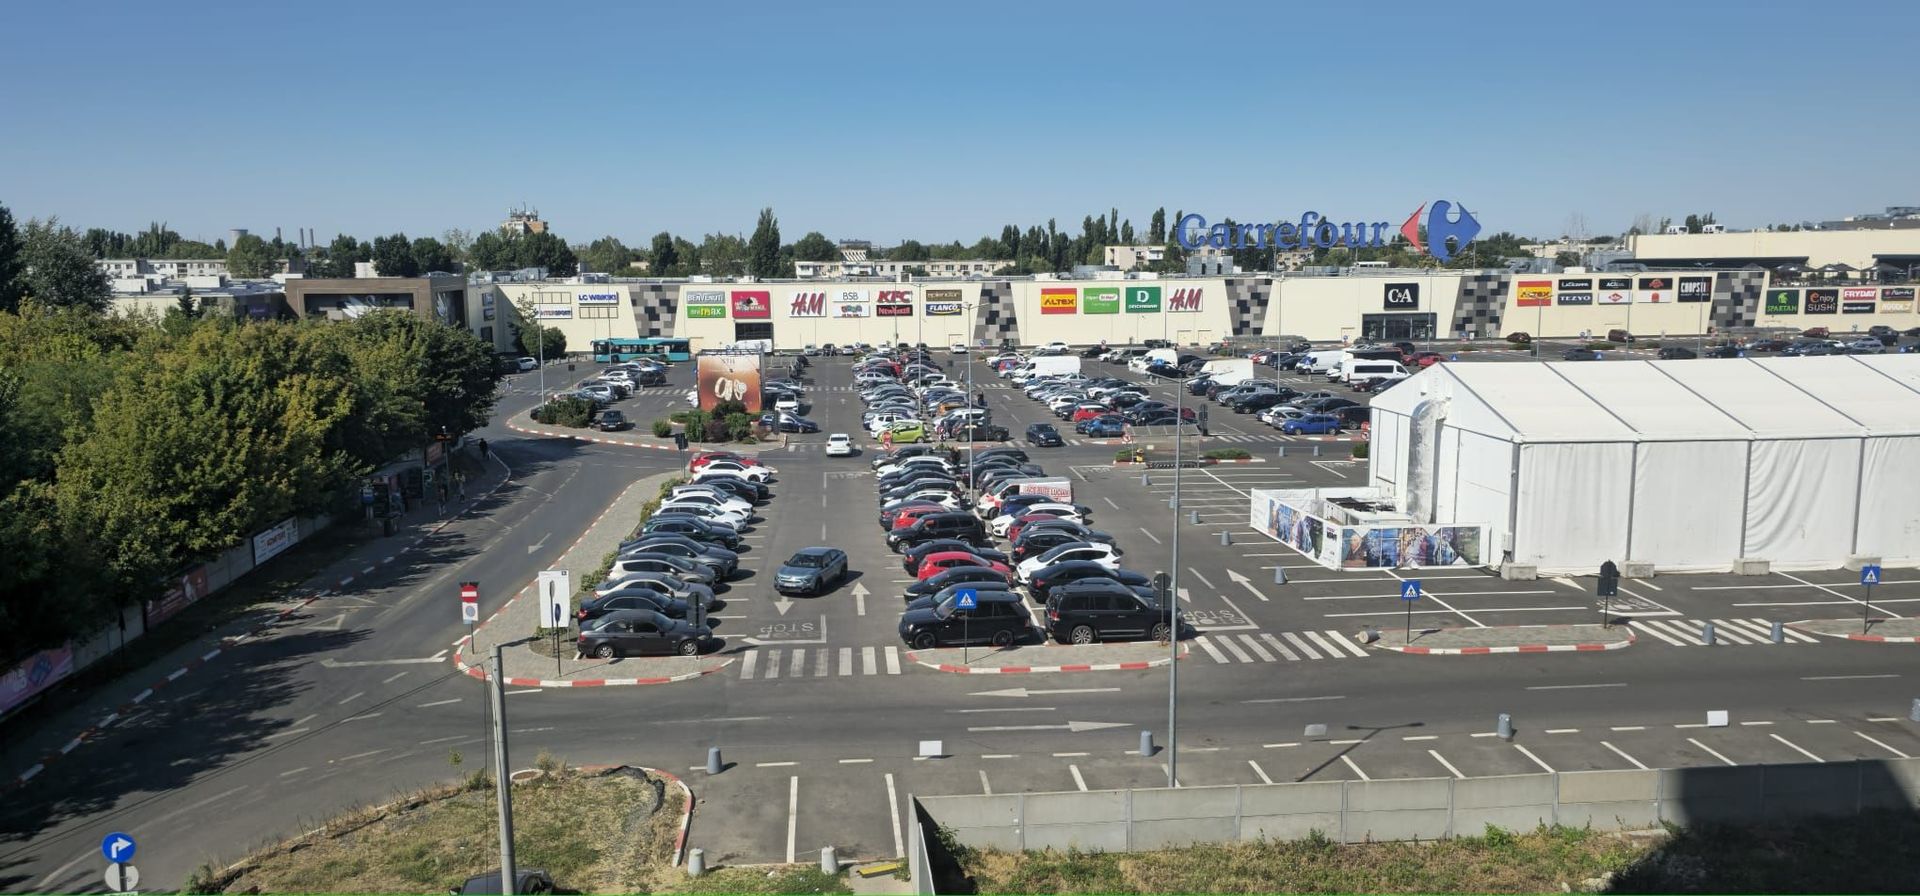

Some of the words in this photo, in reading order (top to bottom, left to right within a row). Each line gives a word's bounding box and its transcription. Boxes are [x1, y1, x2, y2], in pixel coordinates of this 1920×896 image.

[1176, 211, 1389, 250] Carrefour
[687, 292, 724, 302] BENVENUTI
[842, 292, 859, 301] BSB
[878, 290, 912, 303] KFC
[1136, 290, 1150, 303] D
[1169, 288, 1203, 311] H&M
[1387, 288, 1414, 303] C&A
[1809, 292, 1835, 303] Enjoy
[1844, 290, 1876, 298] FRYDAY
[791, 292, 825, 316] H&M
[1044, 298, 1075, 306] ALTEX
[1183, 610, 1235, 620] STOP
[760, 622, 815, 633] STOP
